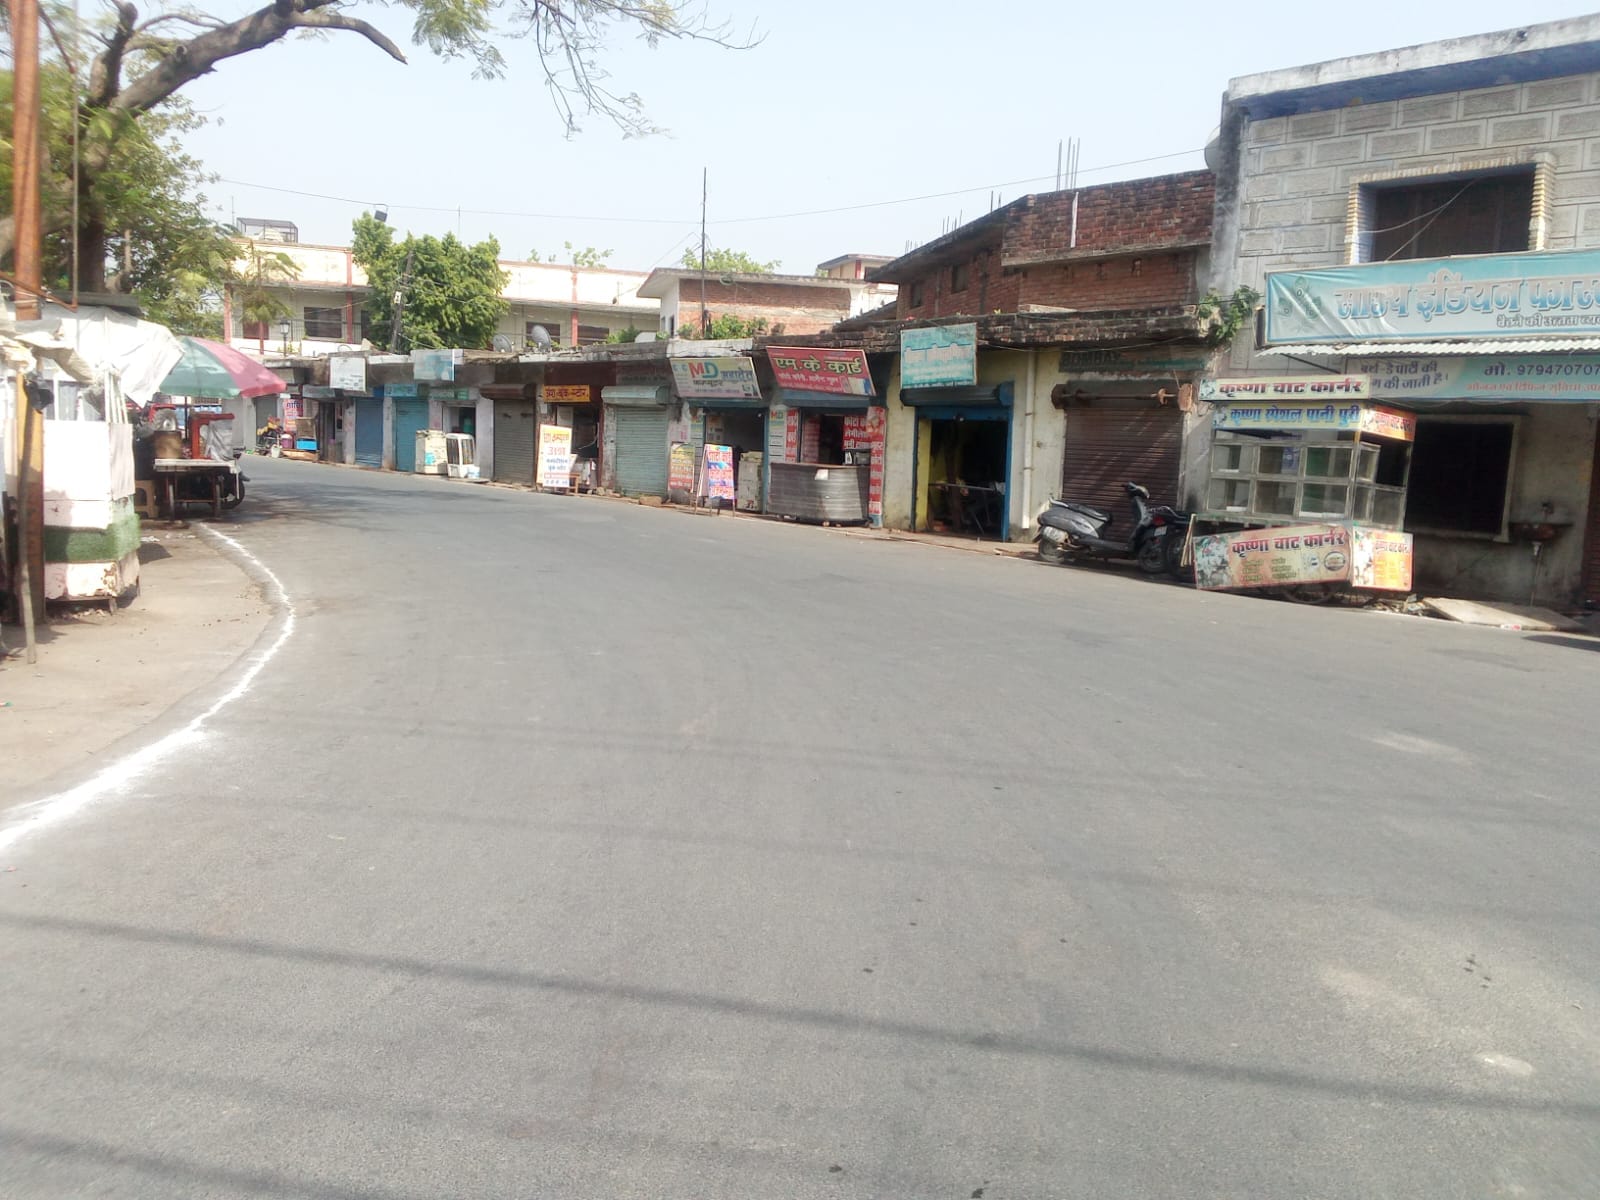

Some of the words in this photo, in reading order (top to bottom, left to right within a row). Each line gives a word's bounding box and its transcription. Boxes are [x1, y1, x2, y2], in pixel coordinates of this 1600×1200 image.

[1415, 268, 1522, 322] इंडियन
[1525, 312, 1543, 327] की
[688, 361, 719, 378] MD
[1421, 360, 1438, 374] की
[1218, 383, 1268, 398] कृष्णा
[1272, 381, 1306, 394] चाट
[1310, 379, 1362, 393] कार्नर
[1384, 375, 1400, 390] की
[1402, 374, 1431, 389] जाती
[1230, 408, 1262, 426] कृष्णा
[1306, 404, 1335, 423] पानी
[1232, 539, 1269, 558] कृष्णा
[1274, 535, 1301, 551] चाट
[1304, 530, 1346, 548] कार्नर
